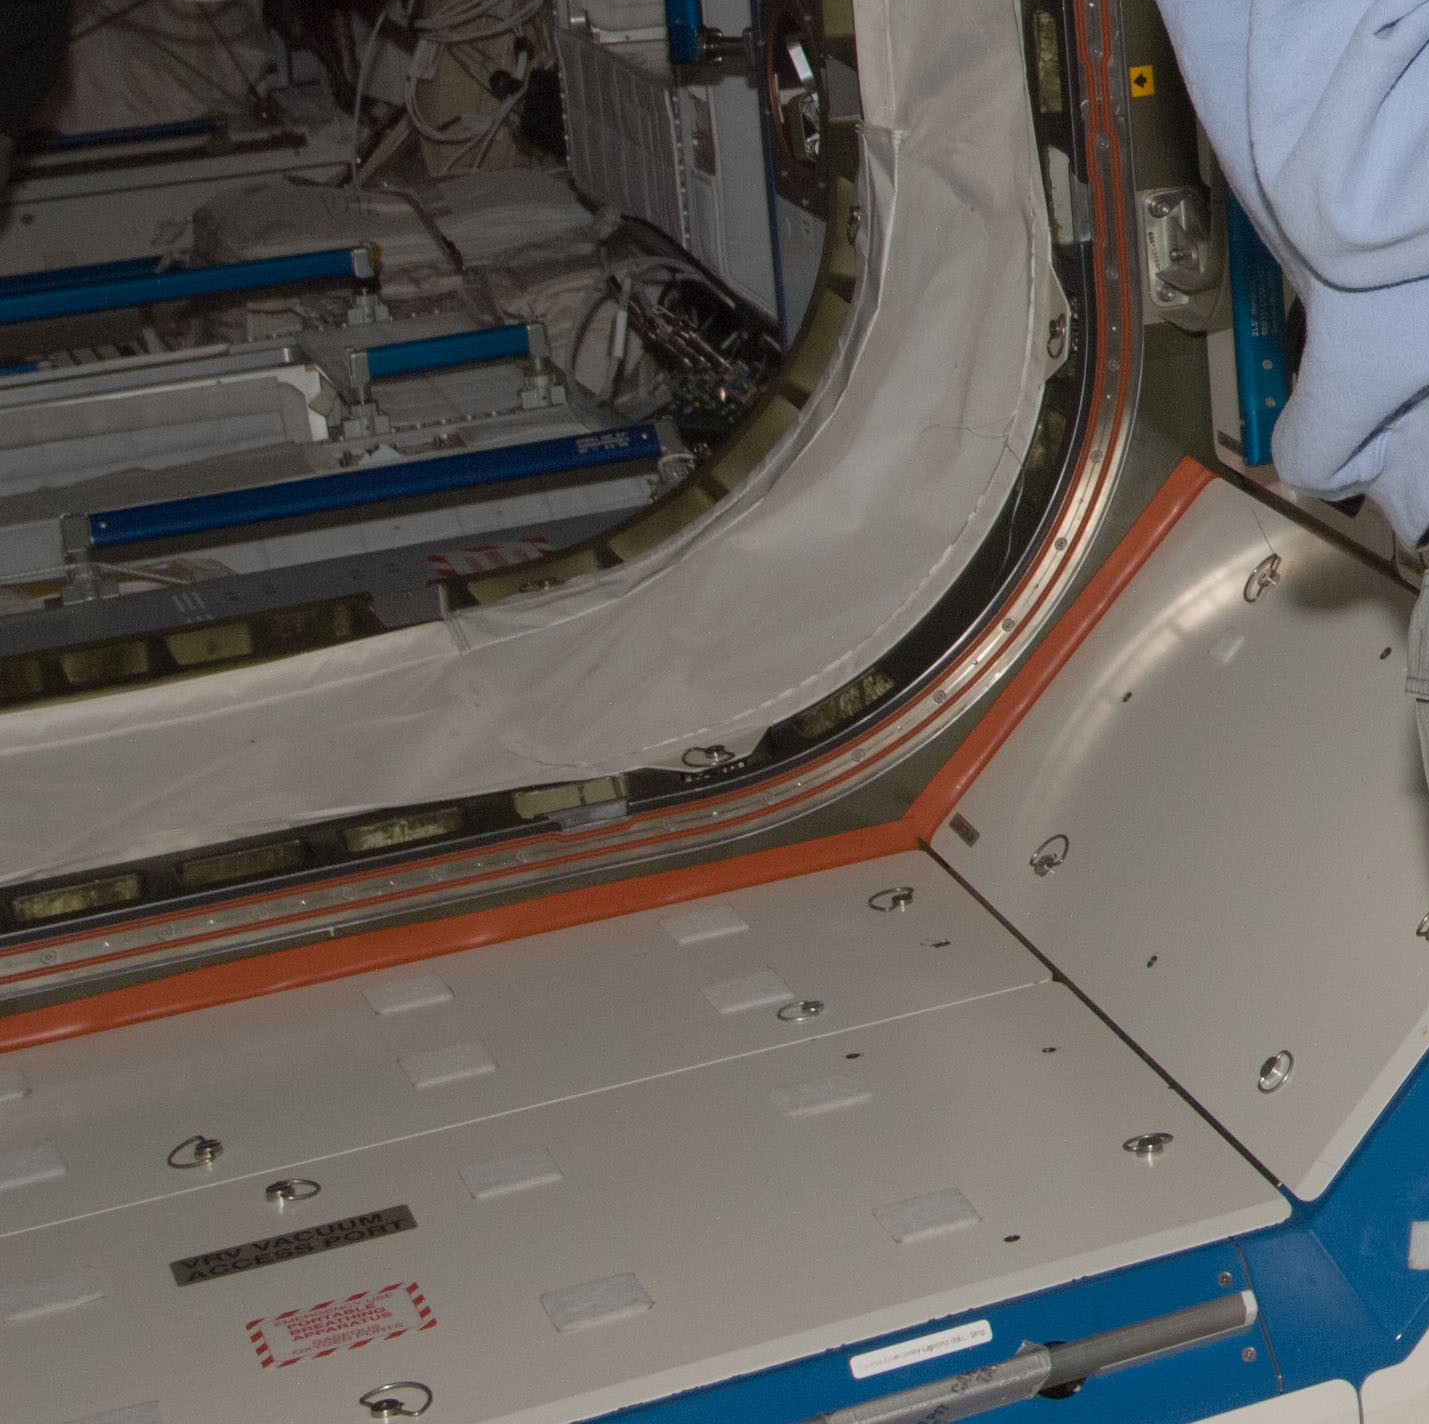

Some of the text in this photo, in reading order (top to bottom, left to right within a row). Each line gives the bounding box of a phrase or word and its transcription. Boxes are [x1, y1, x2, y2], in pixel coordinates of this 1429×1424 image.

[181, 1212, 383, 1269] VRV VACUUM
[188, 1219, 411, 1282] ACCESS PORT
[286, 1304, 374, 1328] PORTABLE
[289, 1308, 385, 1334] BREATHING
[292, 1312, 391, 1340] APPARATUS
